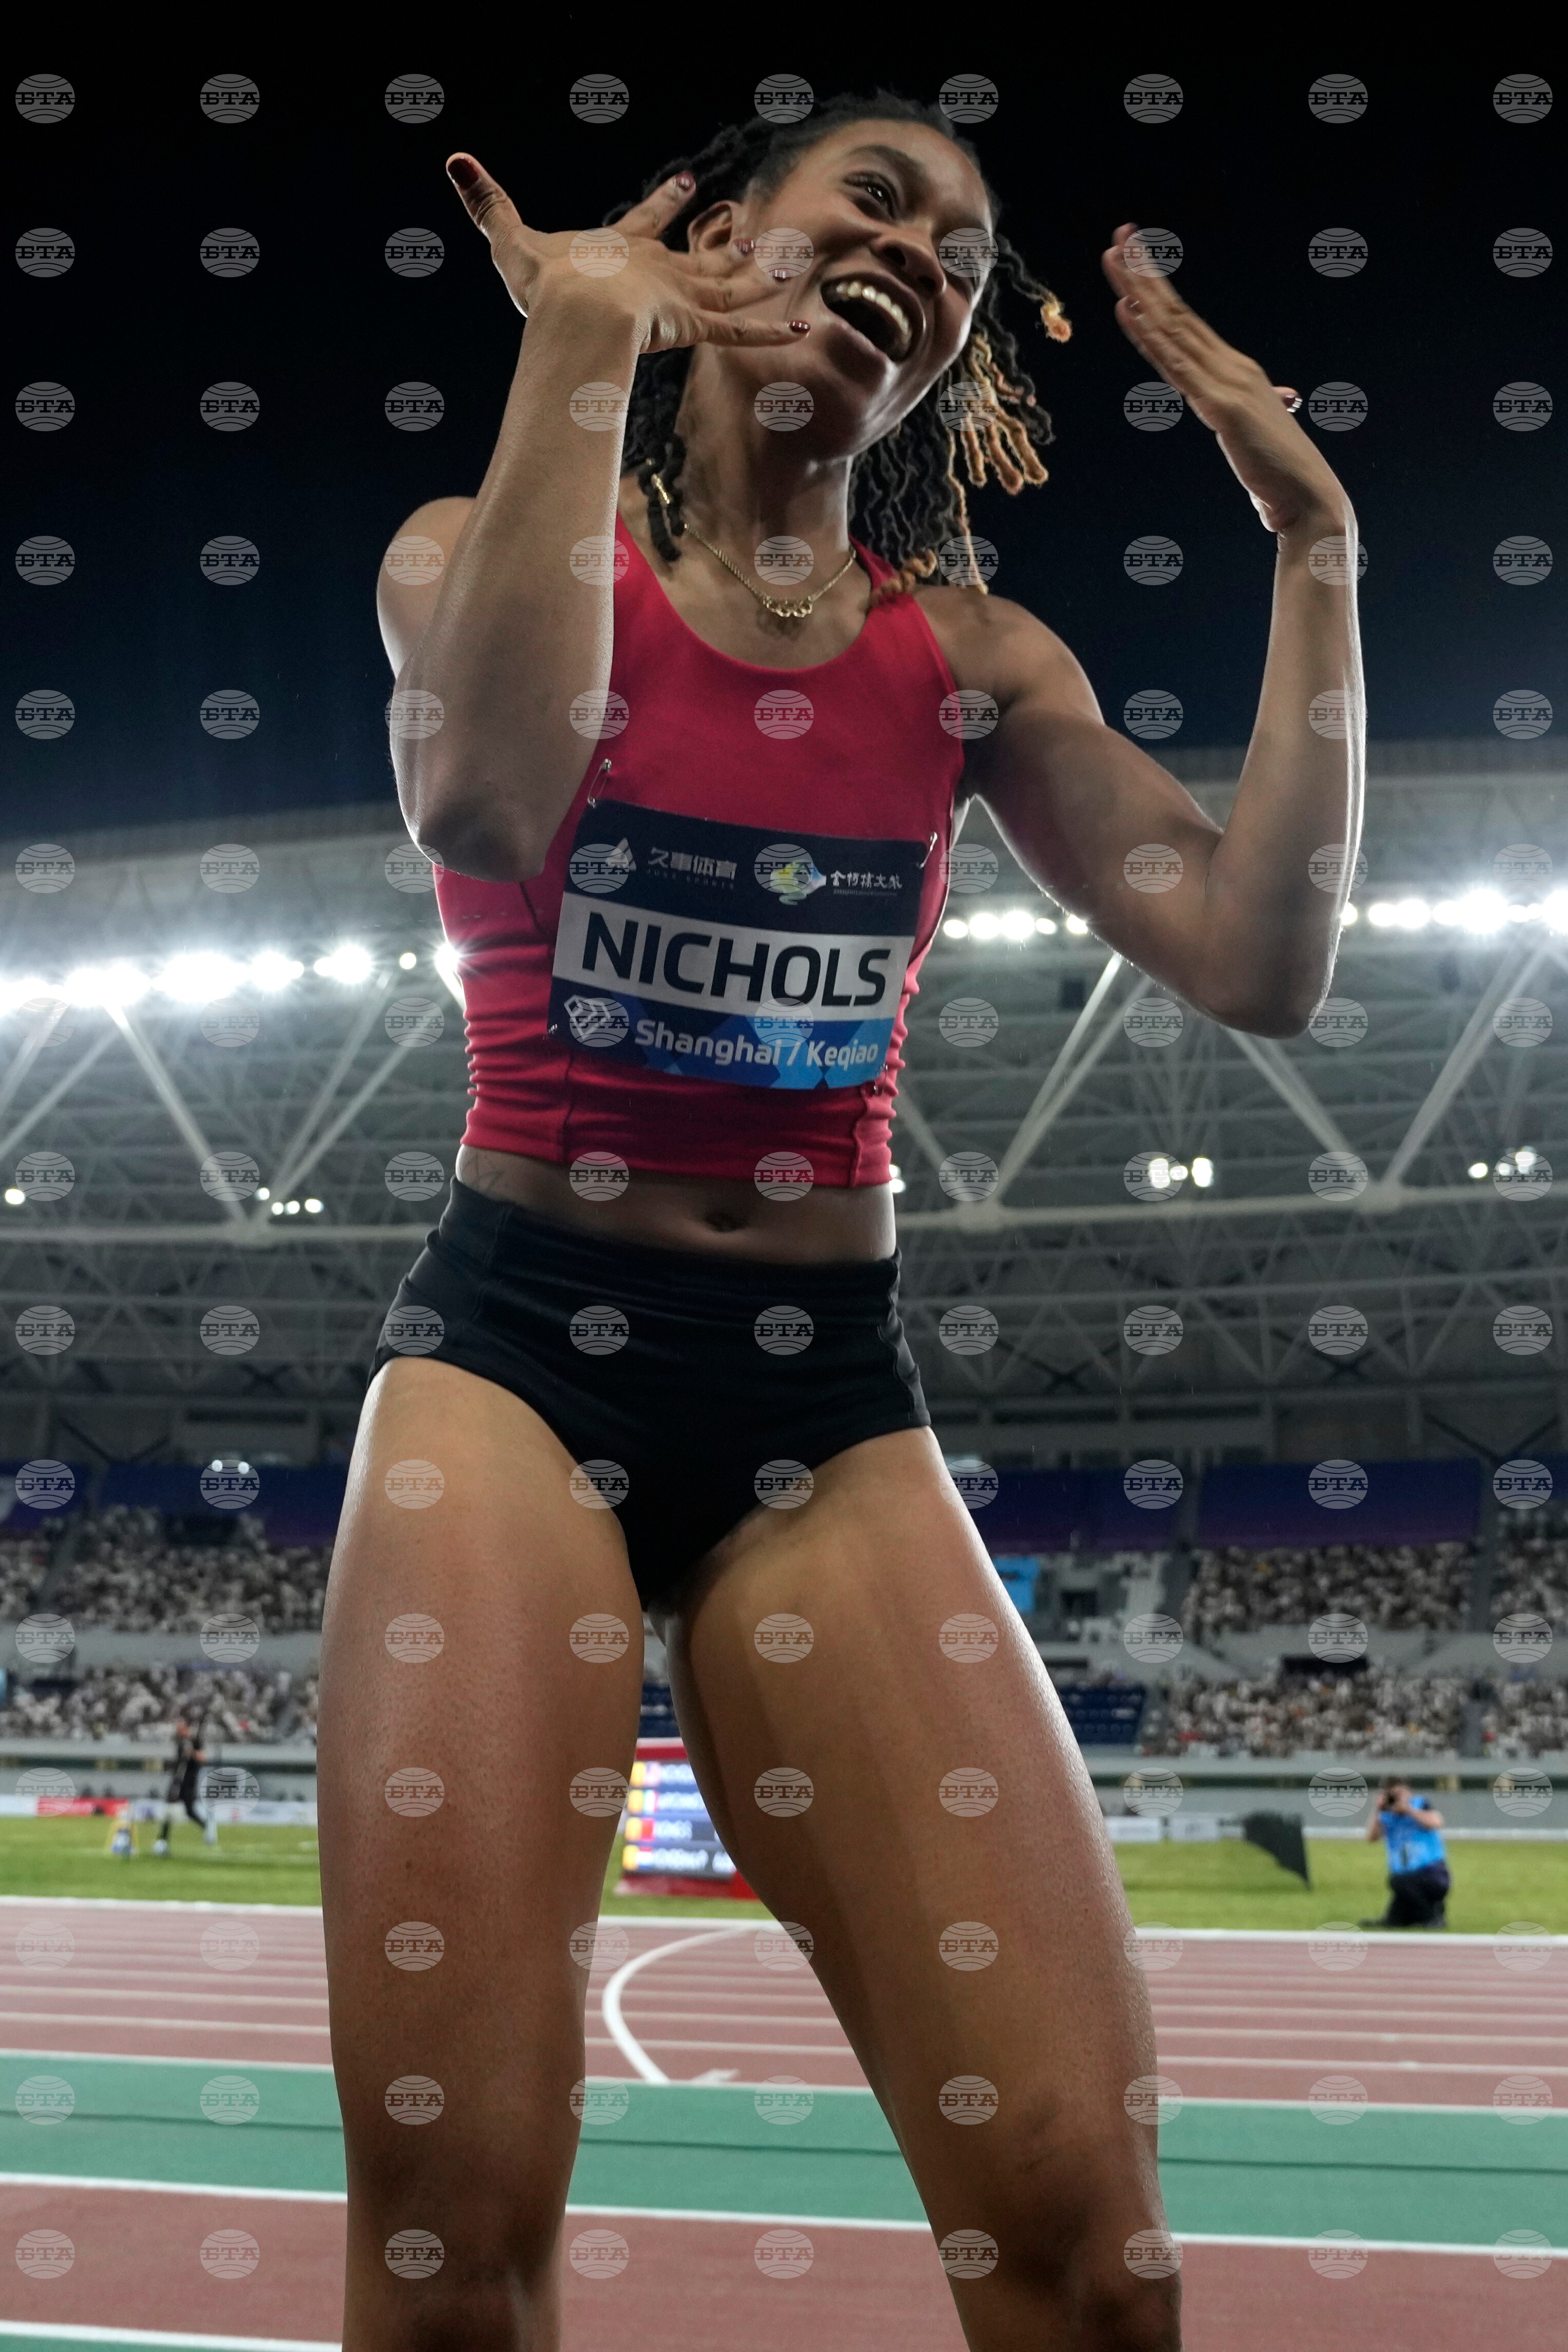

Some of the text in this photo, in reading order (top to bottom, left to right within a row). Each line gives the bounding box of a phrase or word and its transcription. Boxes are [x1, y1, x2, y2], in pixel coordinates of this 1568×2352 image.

[648, 847, 737, 880] 久事体育
[581, 911, 891, 1008] NICHOLS
[635, 1019, 878, 1071] Shanghai / Keqiao
